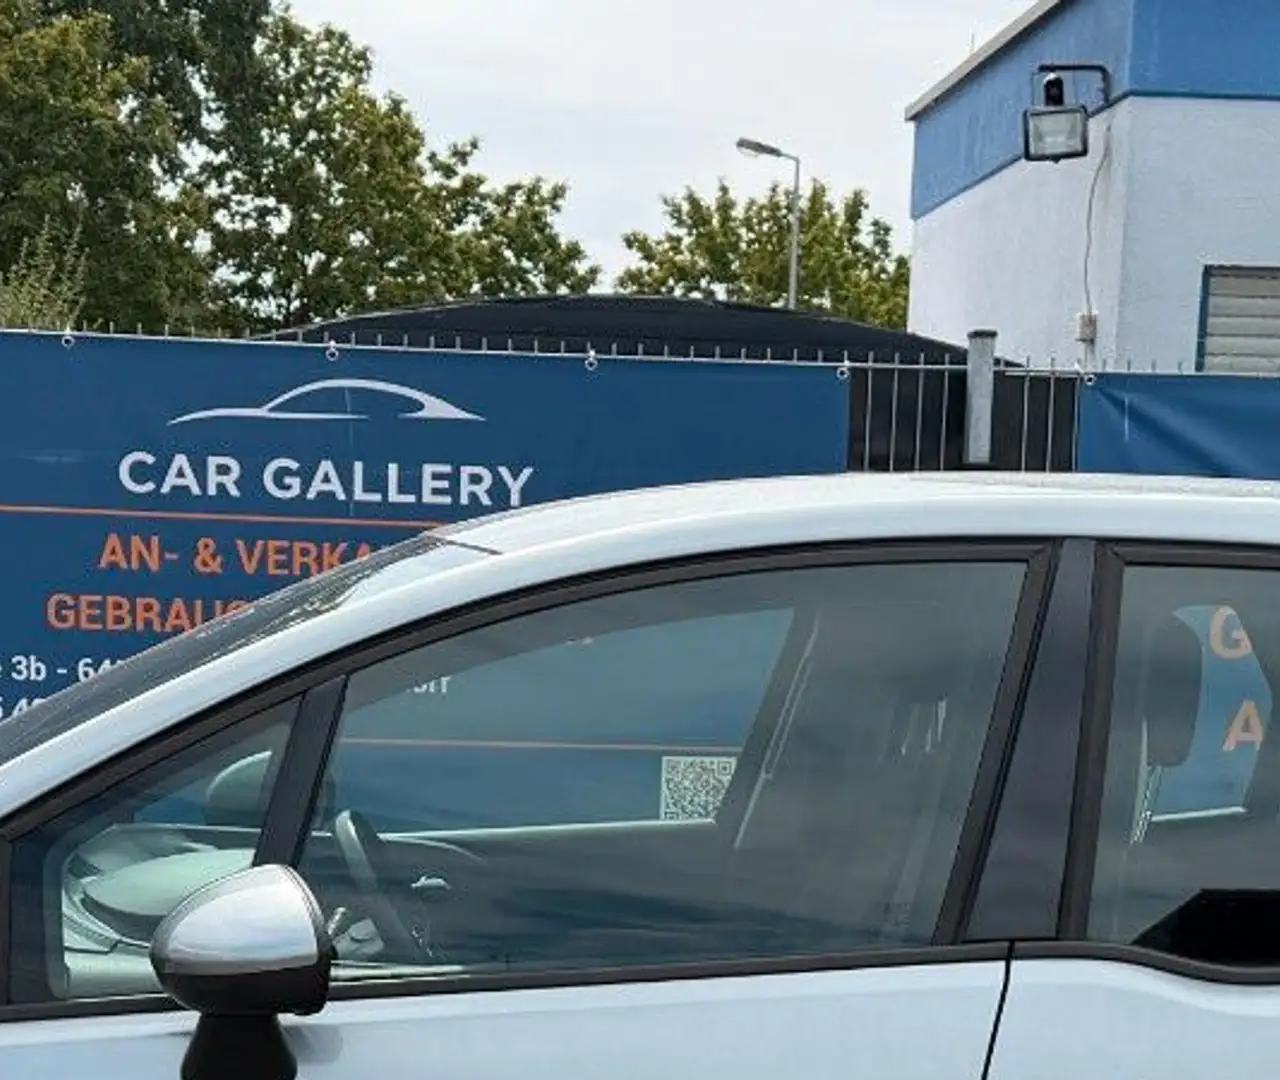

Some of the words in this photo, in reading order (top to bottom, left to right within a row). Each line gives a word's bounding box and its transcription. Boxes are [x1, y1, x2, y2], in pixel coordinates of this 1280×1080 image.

[119, 450, 240, 498] CAR
[262, 457, 533, 507] GALLERY
[99, 533, 178, 572] AN-
[195, 538, 223, 573] &
[237, 540, 372, 577] VERK
[10, 655, 47, 680] 3b
[78, 657, 128, 682] 64
